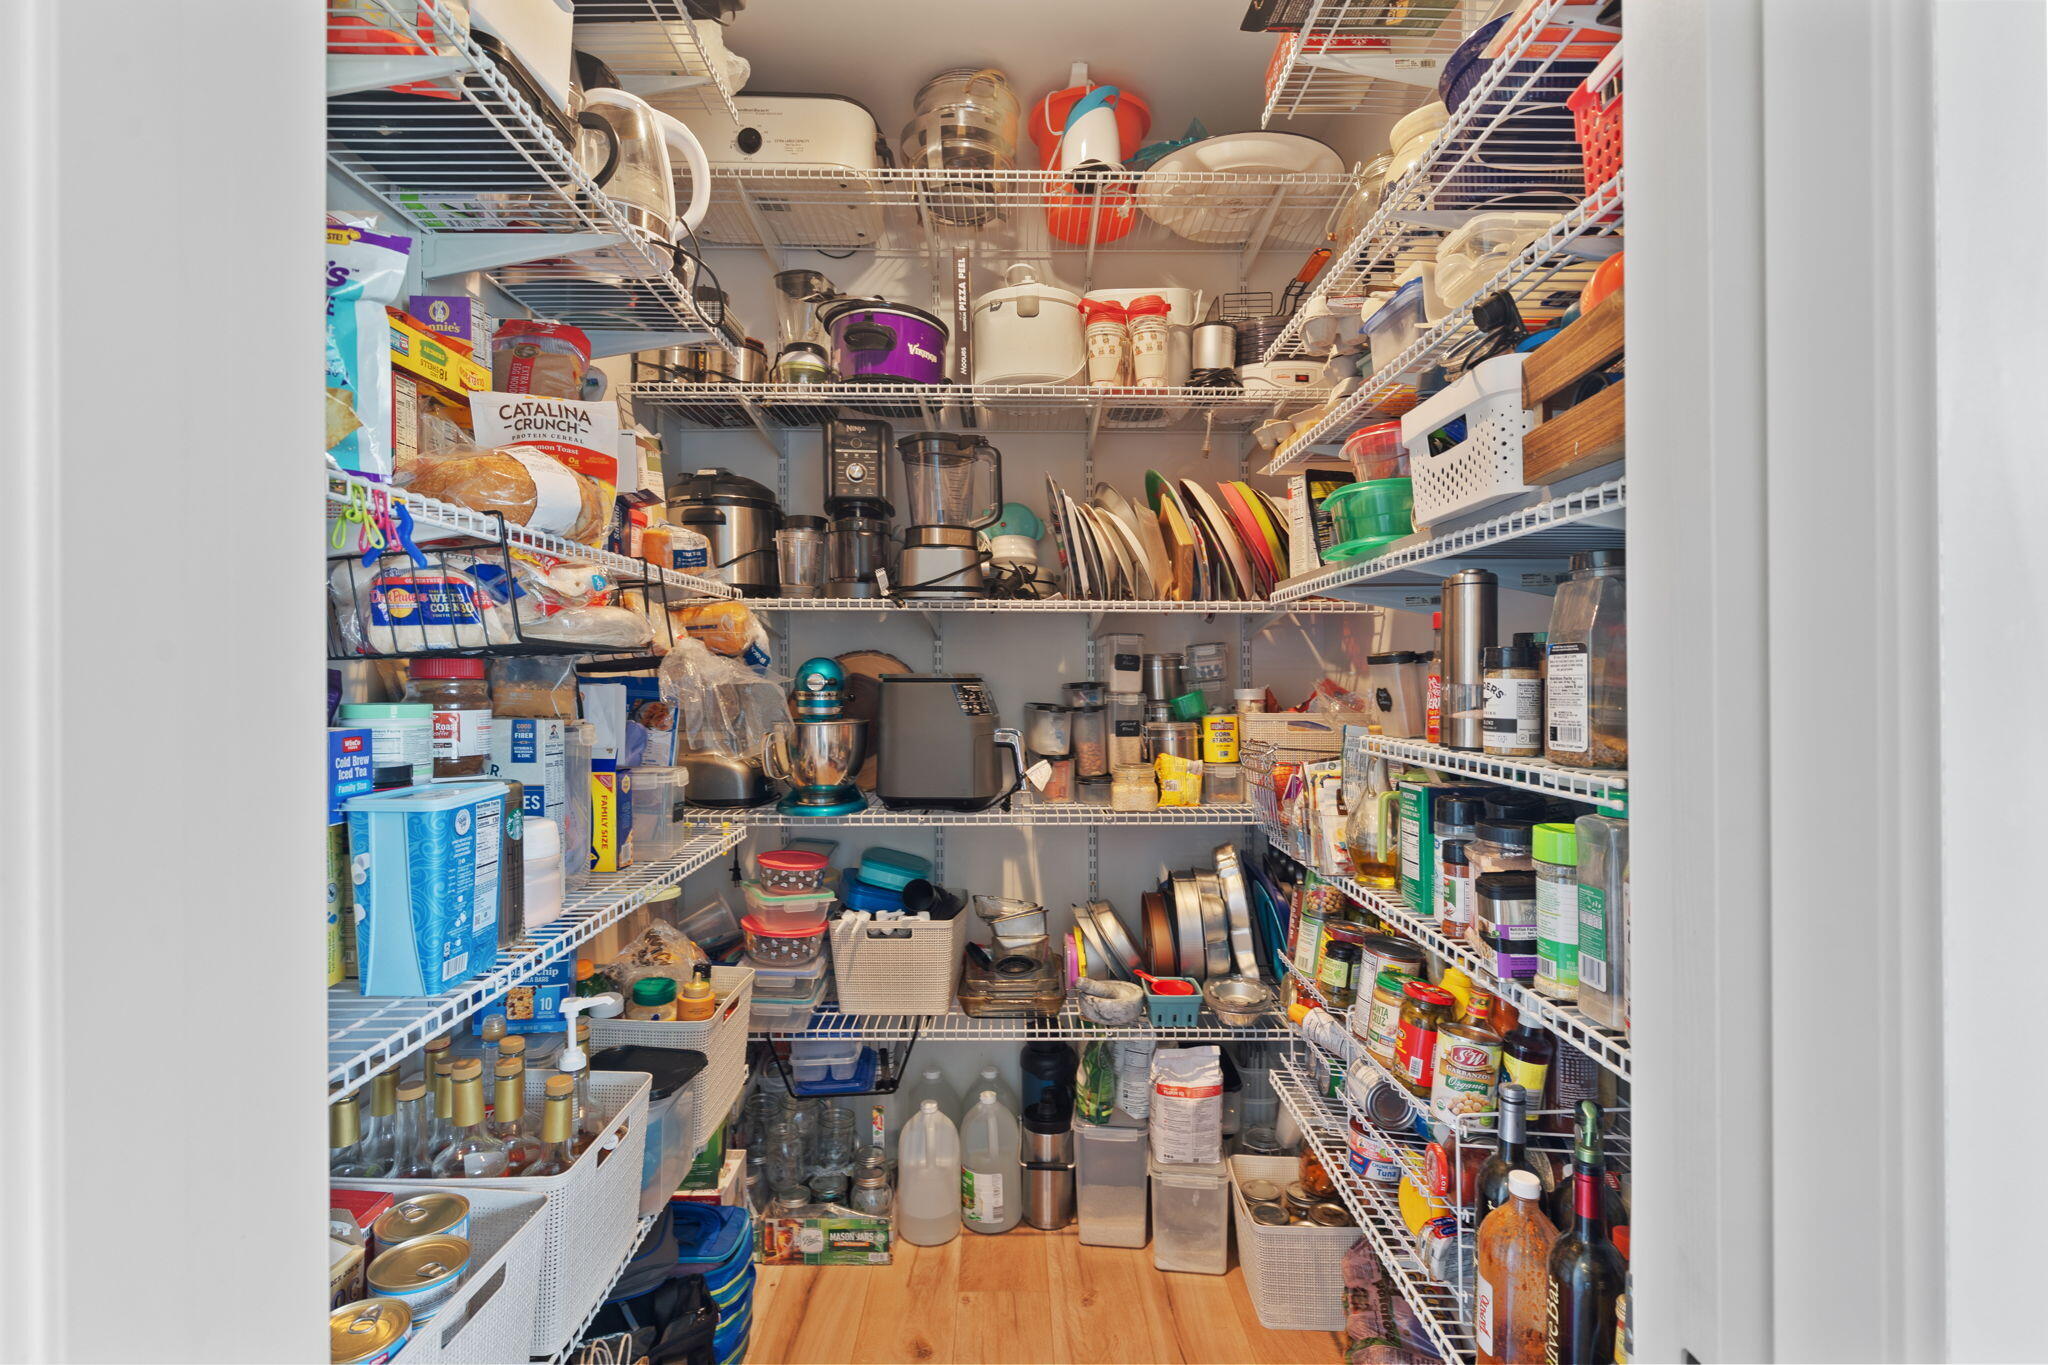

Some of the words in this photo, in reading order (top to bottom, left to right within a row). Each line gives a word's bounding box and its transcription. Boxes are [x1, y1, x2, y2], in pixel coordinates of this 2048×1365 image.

[957, 257, 966, 279] PEEL
[958, 281, 967, 311] PIZZA
[428, 321, 461, 333] nnie's
[499, 402, 592, 426] CATALINA
[514, 418, 578, 434] CRUNCH
[512, 433, 547, 441] PROTEIN
[551, 434, 585, 444] CEREAL
[556, 444, 579, 455] Toast
[435, 723, 459, 731] Roas
[335, 756, 351, 769] Cold
[352, 755, 370, 767] Brew
[338, 768, 353, 781] Iced
[354, 766, 368, 778] Tea
[338, 784, 356, 794] Family
[601, 830, 609, 850] SIZE
[540, 997, 552, 1011] 10
[1448, 1077, 1487, 1091] Organic
[1376, 1168, 1397, 1178] Tuna
[829, 1232, 855, 1241] MASON
[855, 1232, 874, 1241] JARS
